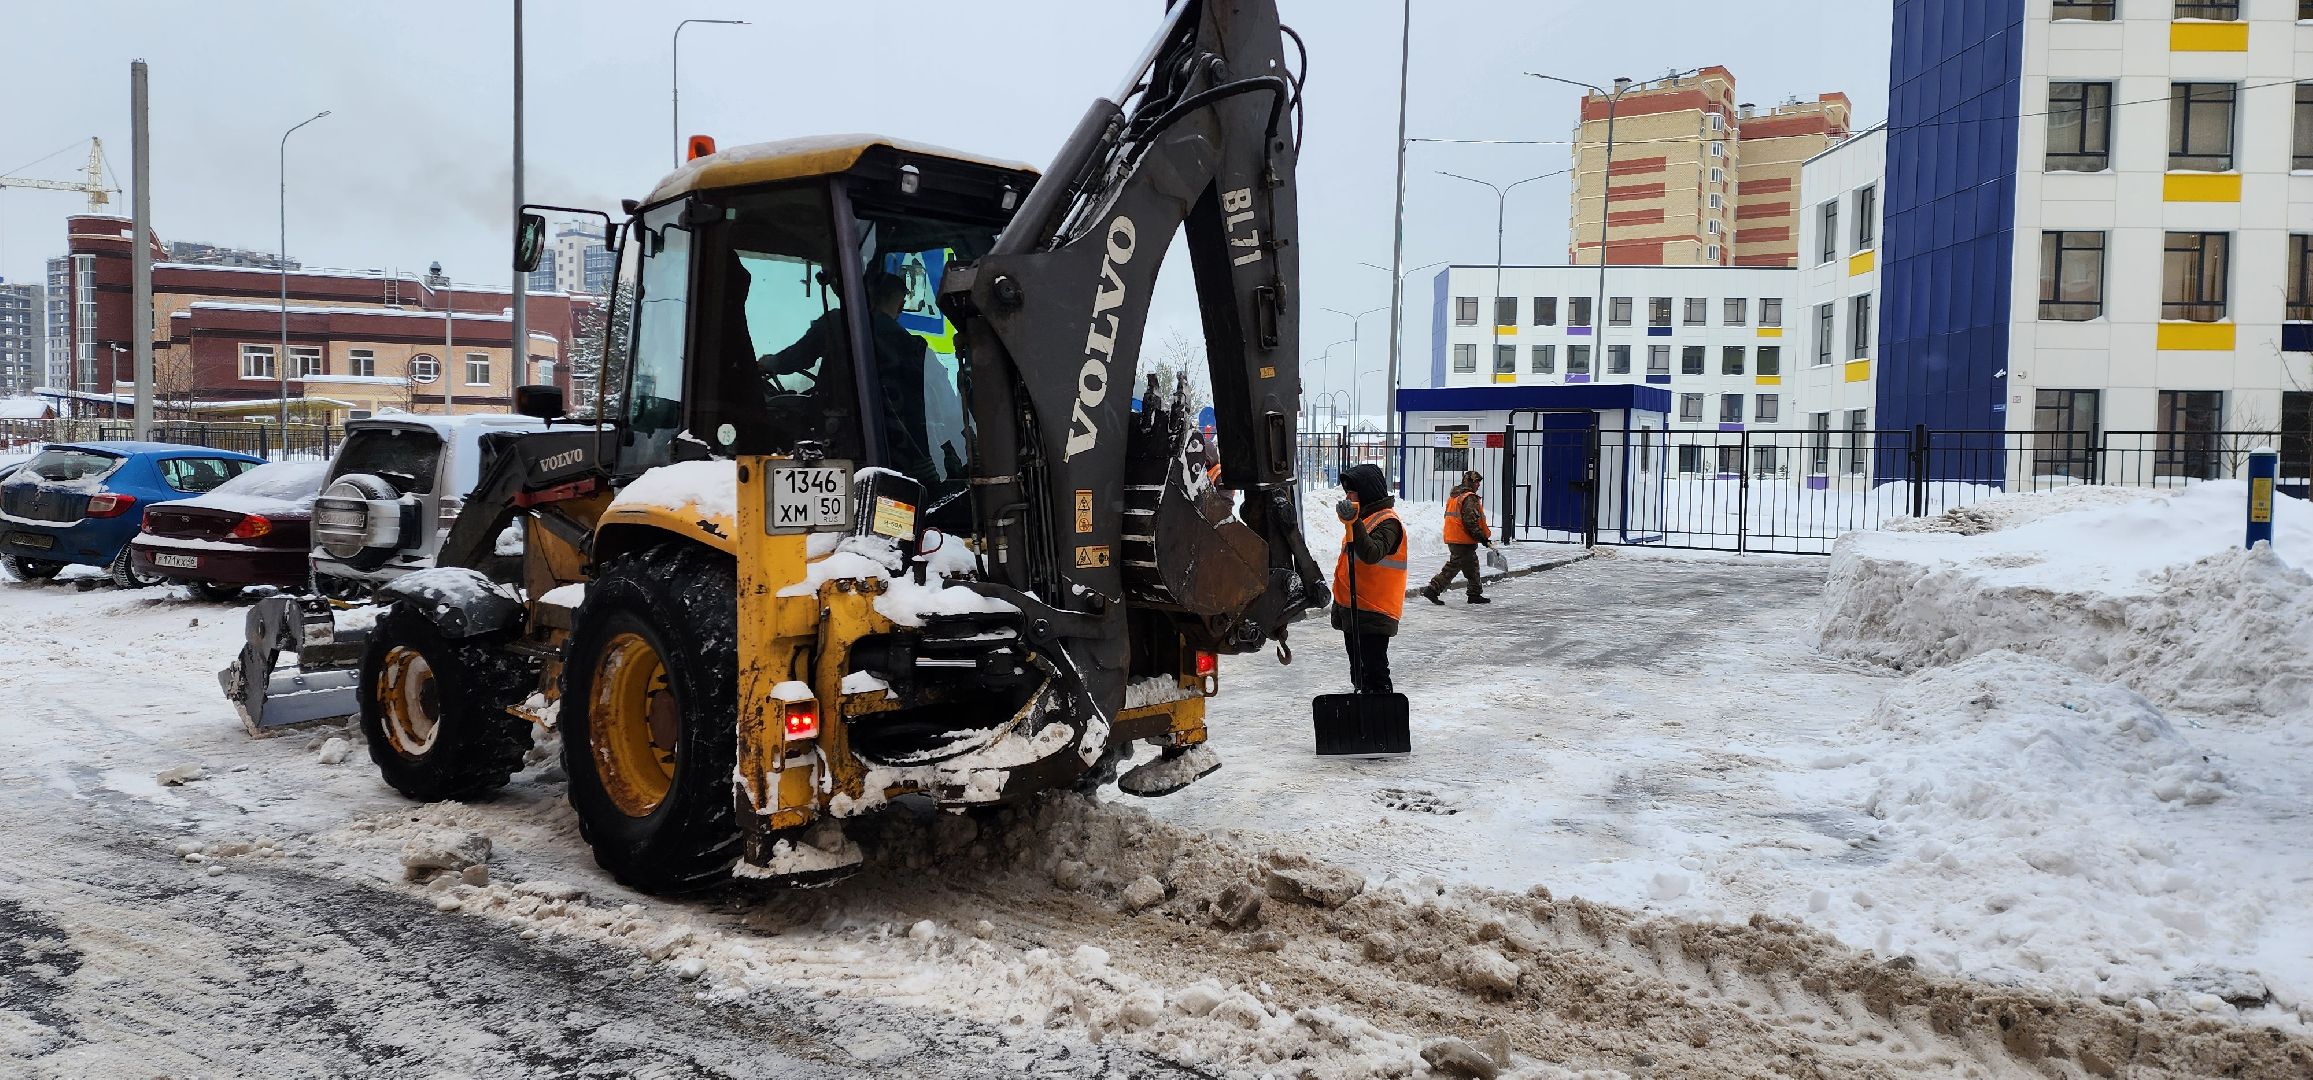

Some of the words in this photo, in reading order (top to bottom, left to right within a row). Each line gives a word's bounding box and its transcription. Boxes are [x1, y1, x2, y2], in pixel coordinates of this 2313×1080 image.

[1222, 187, 1262, 267] BL71
[1063, 215, 1136, 464] VOLVO
[540, 448, 583, 472] VOLVO
[785, 470, 837, 494] 1346
[821, 497, 841, 515] 50
